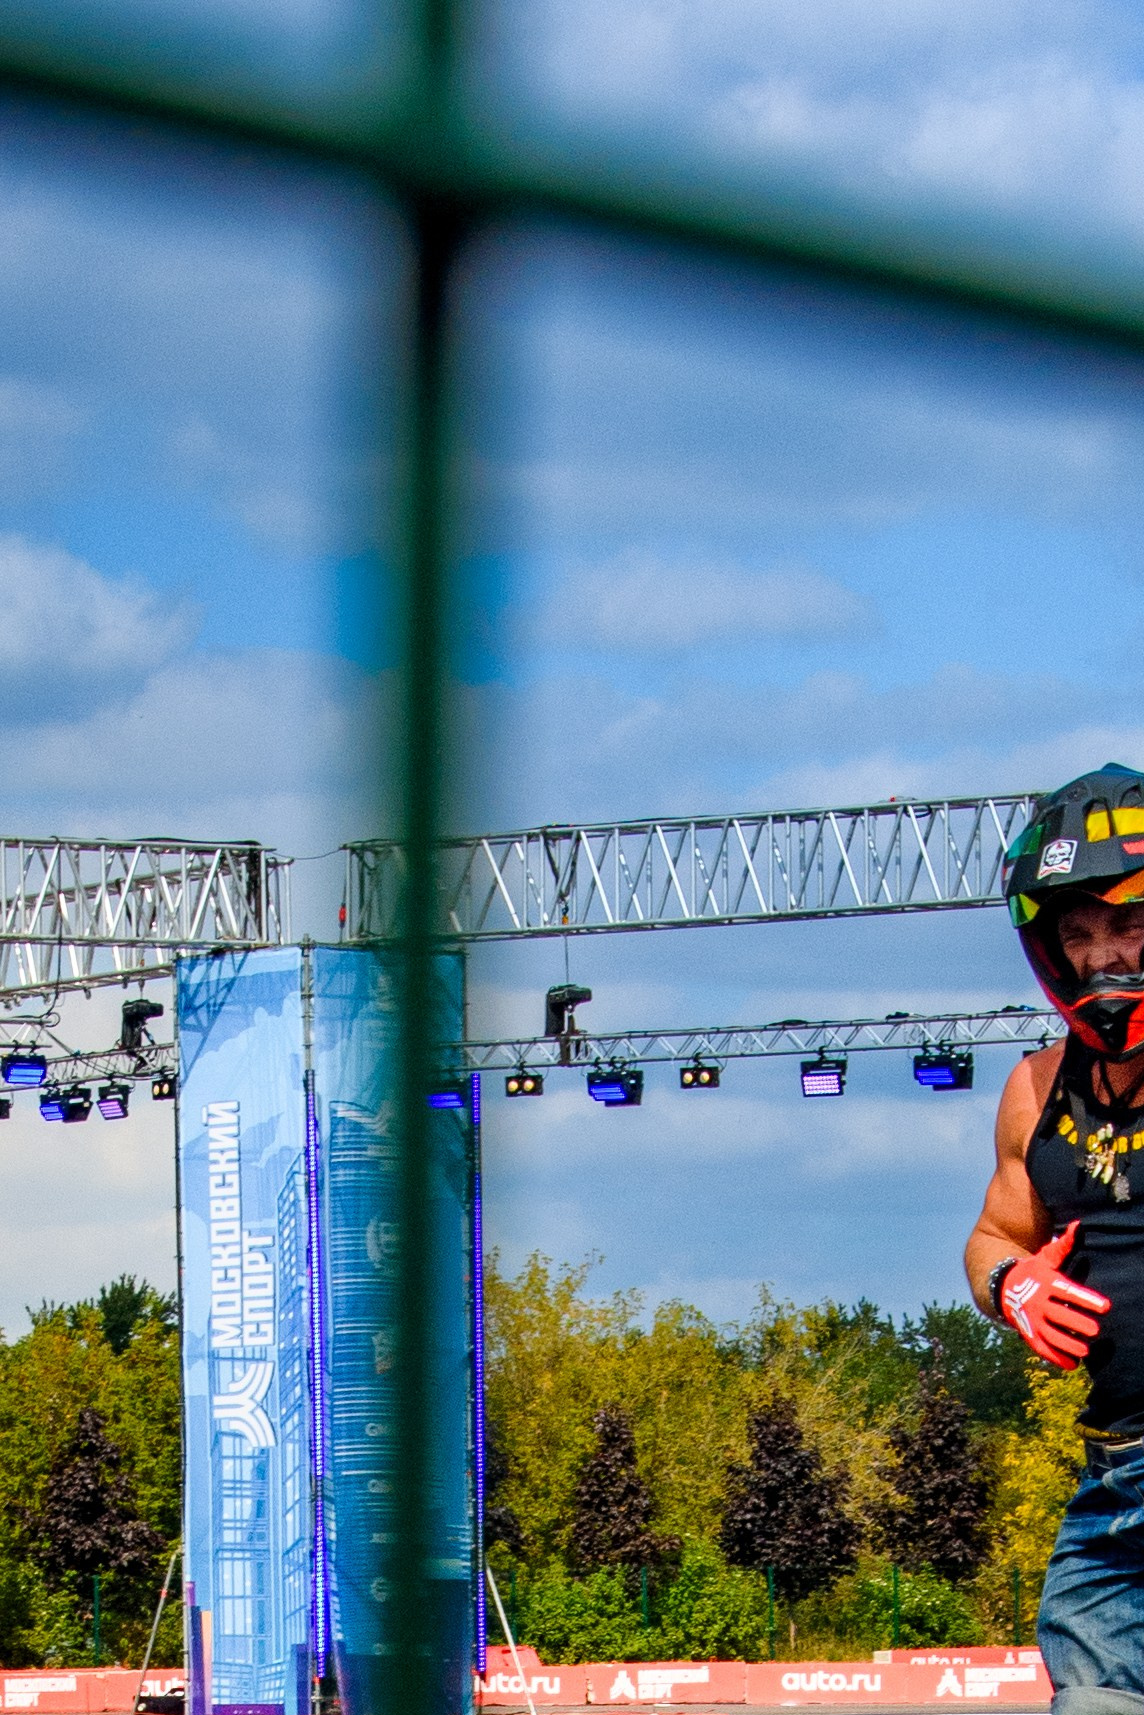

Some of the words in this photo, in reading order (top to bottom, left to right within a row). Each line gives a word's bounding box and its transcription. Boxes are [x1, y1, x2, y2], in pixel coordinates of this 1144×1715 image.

[202, 1100, 241, 1348] МОСКОВСКИЙ
[243, 1230, 276, 1346] СПОРТ
[781, 1671, 881, 1692] auto.ru
